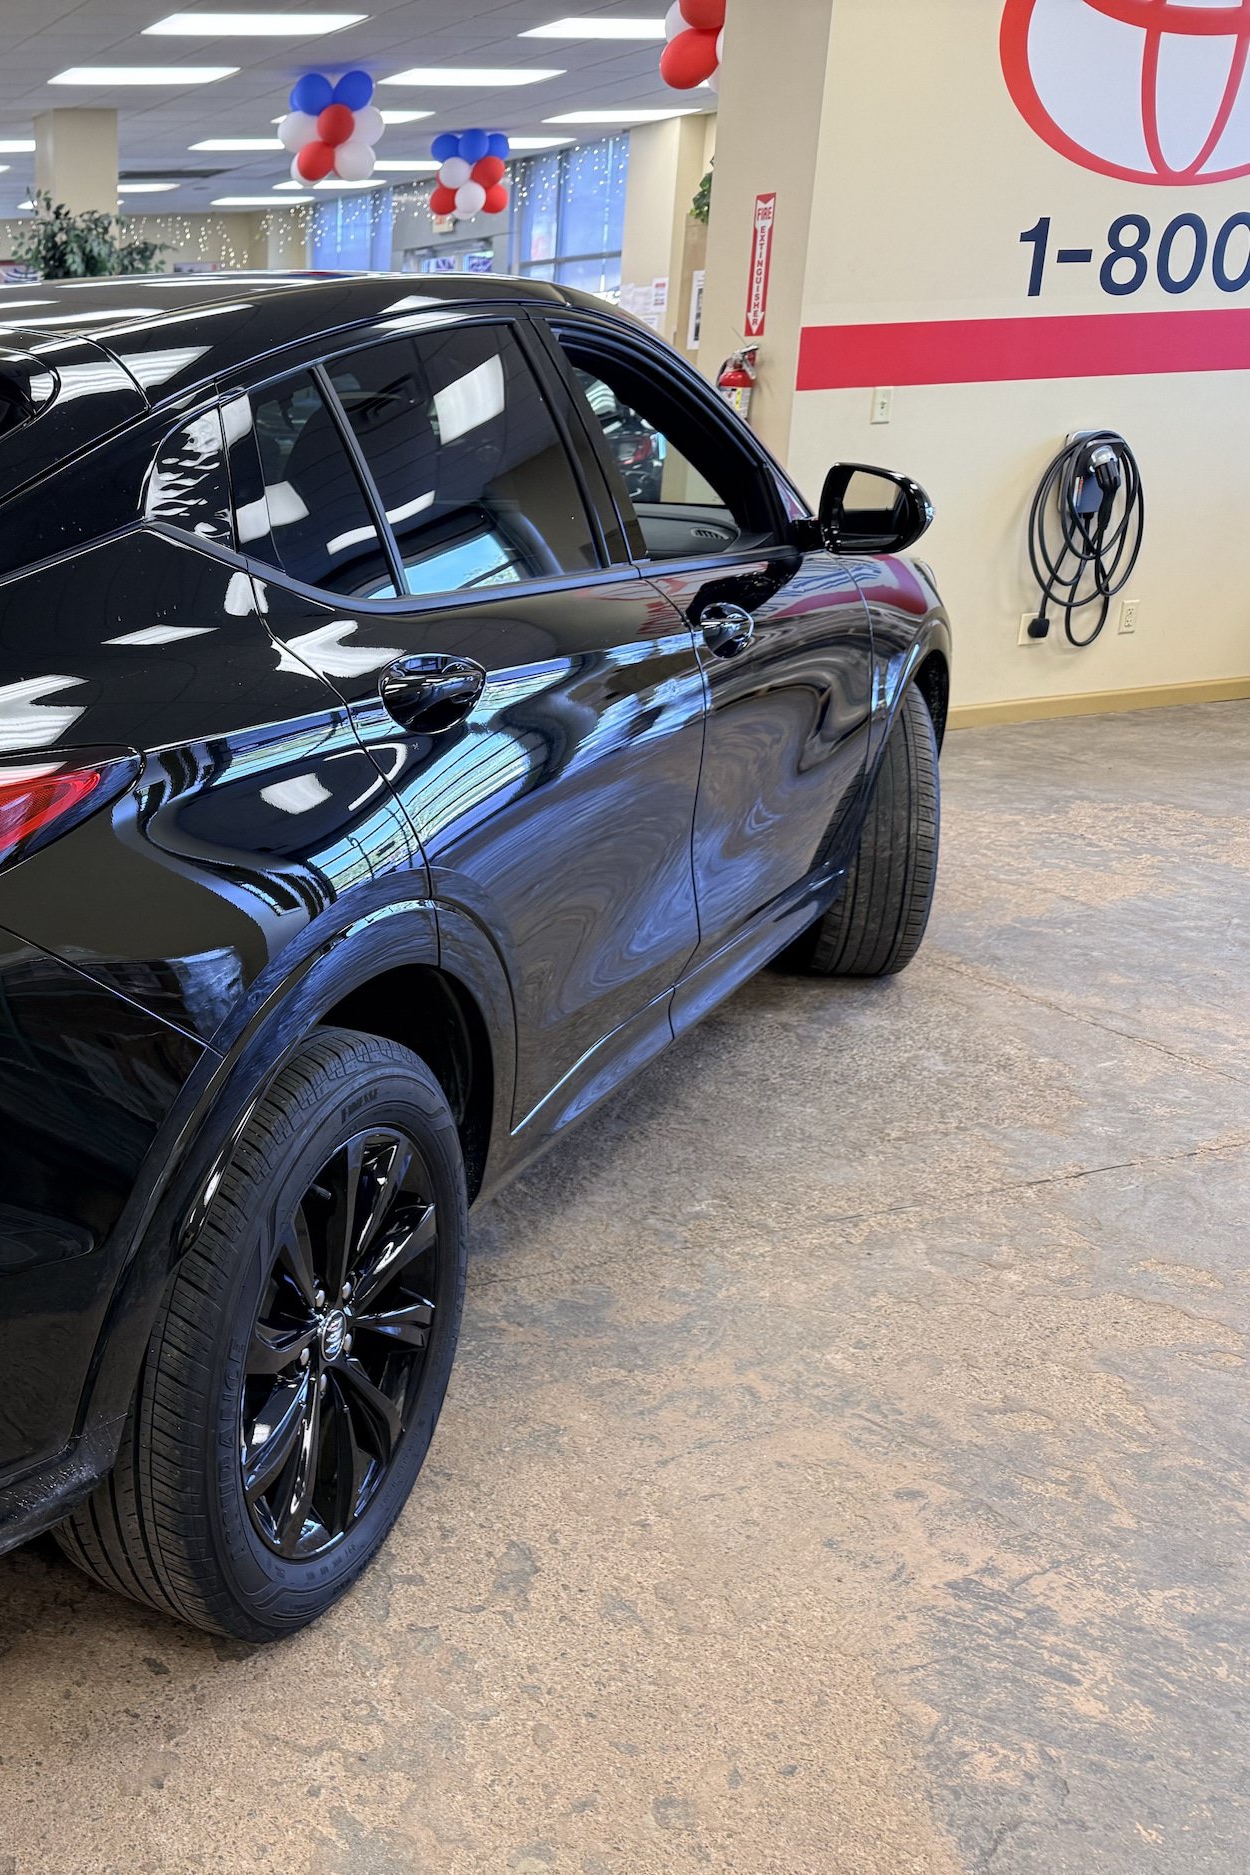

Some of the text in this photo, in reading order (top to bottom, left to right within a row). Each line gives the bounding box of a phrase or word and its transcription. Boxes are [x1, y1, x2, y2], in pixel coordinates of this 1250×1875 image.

[756, 206, 773, 221] FIRE
[1019, 211, 1250, 296] 1-800
[752, 225, 767, 326] EXTINGUISHER
